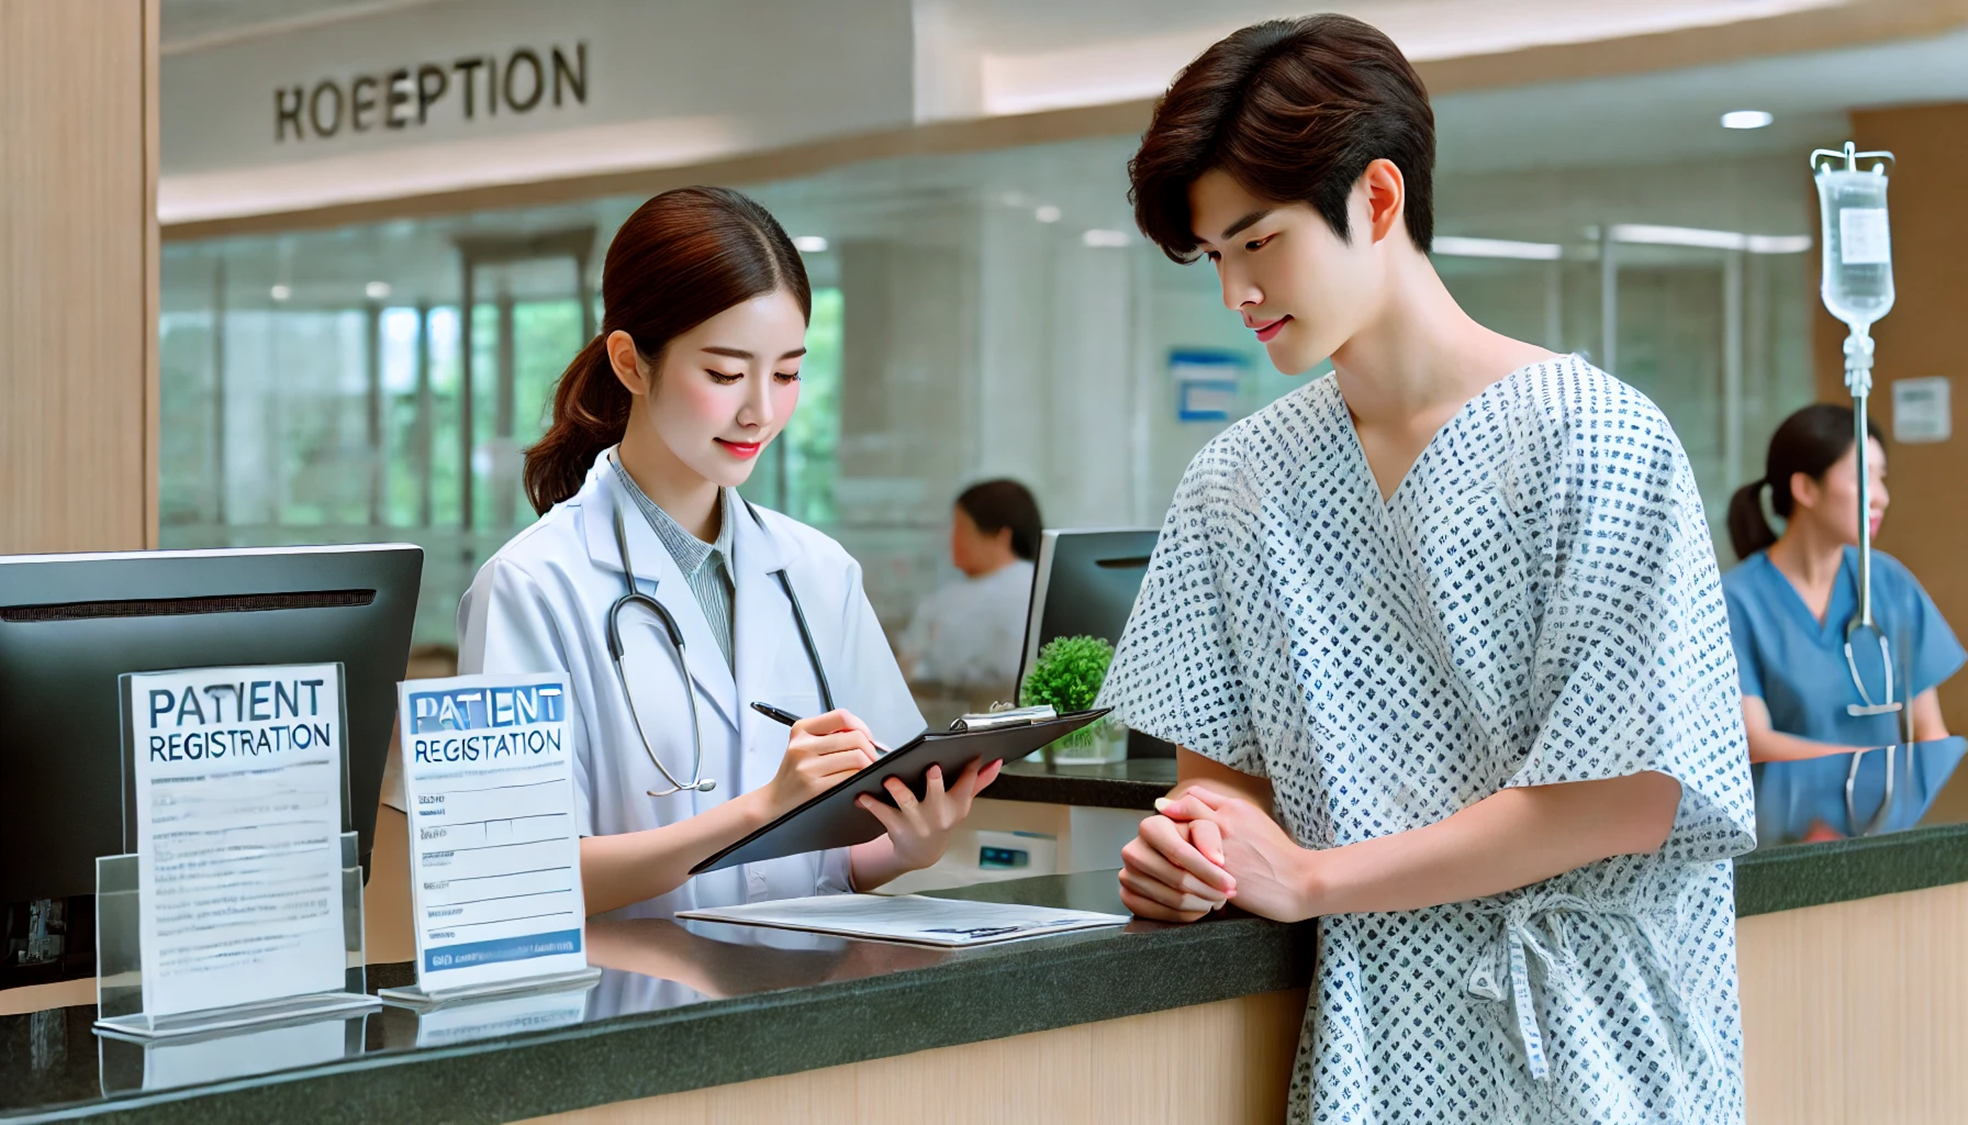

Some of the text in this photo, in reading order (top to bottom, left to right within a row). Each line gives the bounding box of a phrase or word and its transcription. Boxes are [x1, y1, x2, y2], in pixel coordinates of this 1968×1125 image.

[149, 679, 324, 728] PATIENT
[416, 687, 562, 734] PATIENT
[150, 723, 330, 762] REGISTRATION
